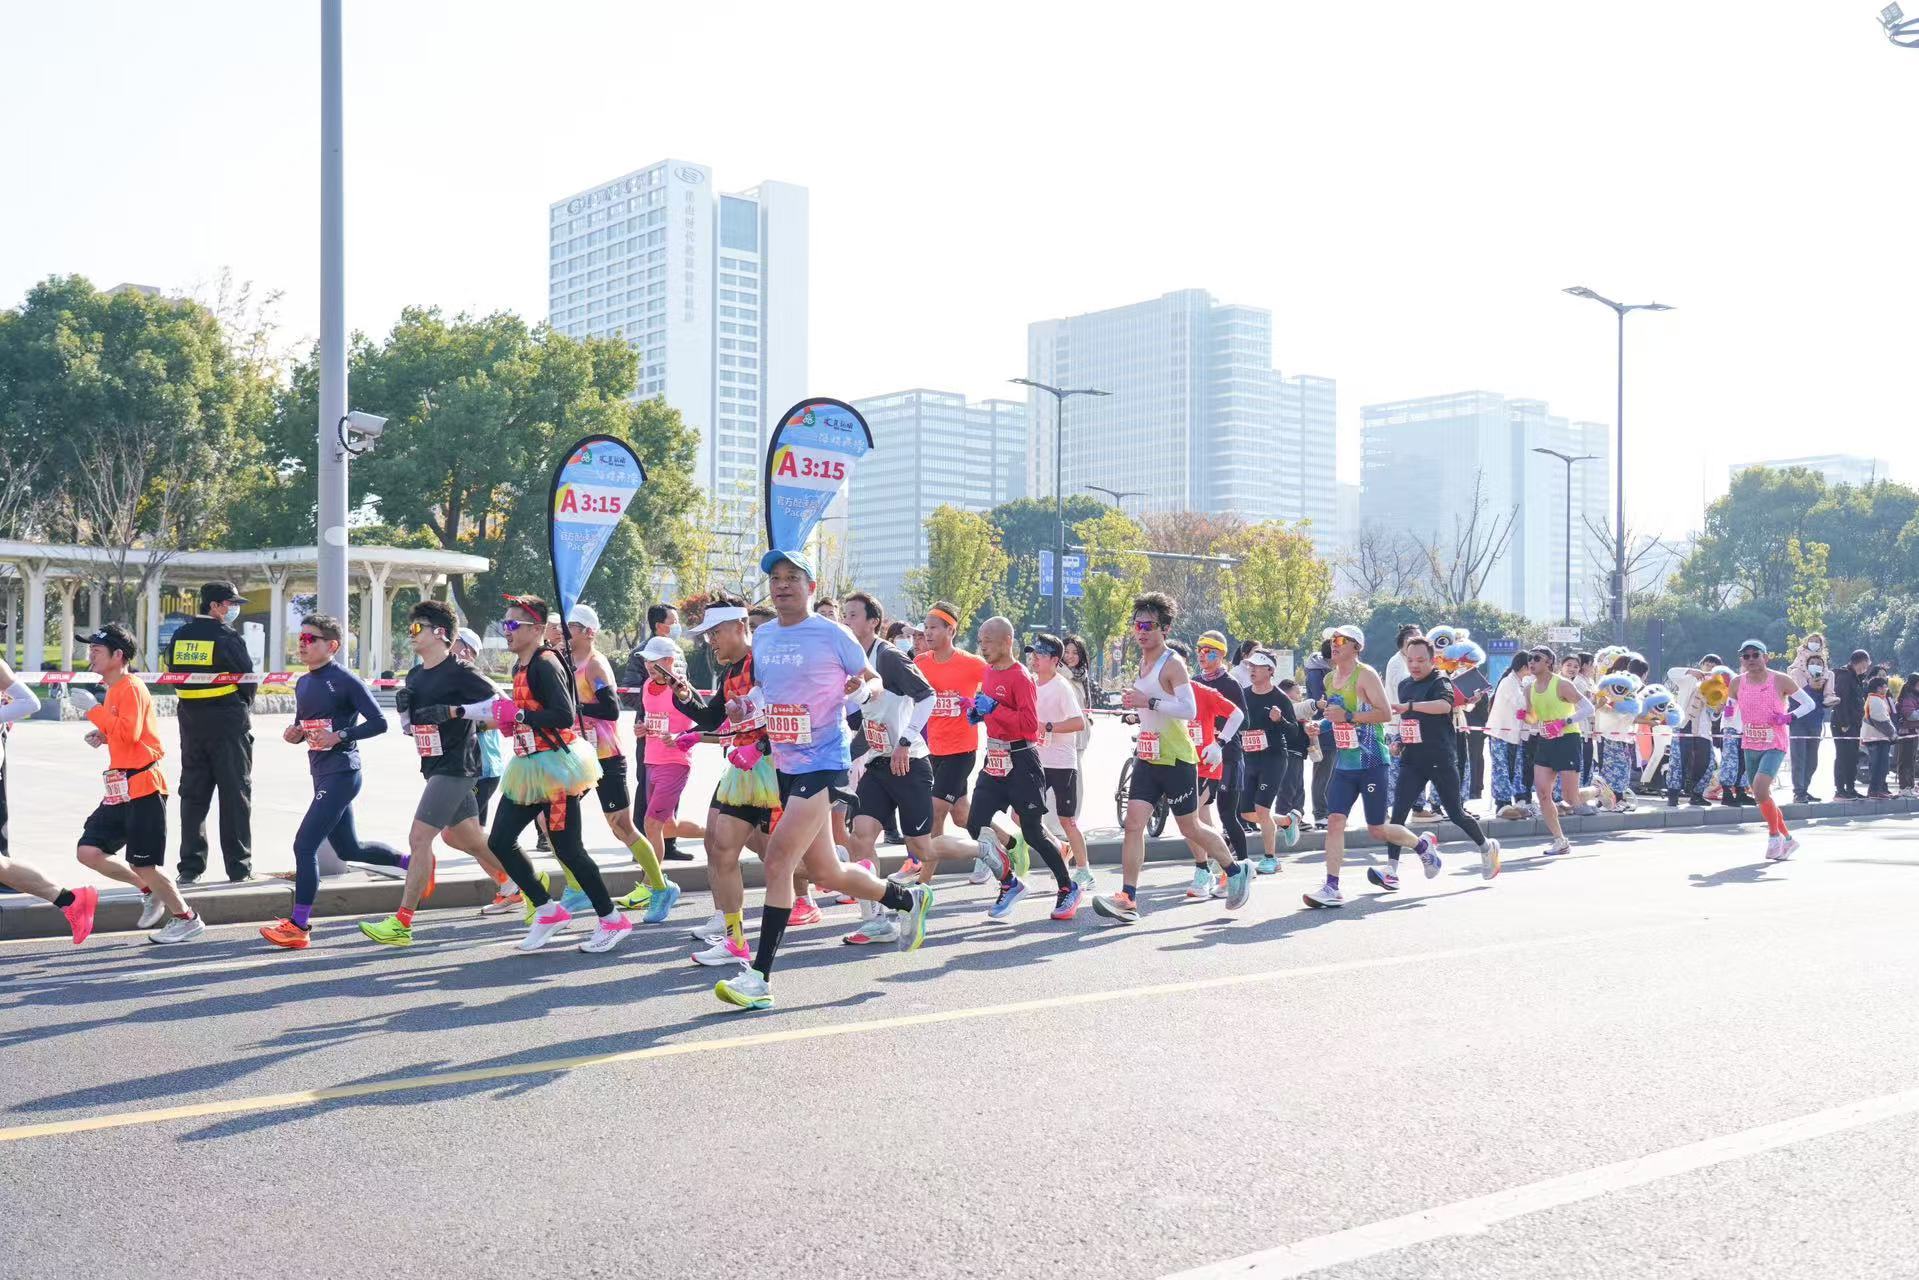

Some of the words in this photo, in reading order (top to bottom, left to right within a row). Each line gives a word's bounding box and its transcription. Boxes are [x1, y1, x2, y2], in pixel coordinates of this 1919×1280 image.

[778, 451, 798, 477] A
[802, 458, 845, 480] 3:15
[561, 489, 578, 513] A
[581, 494, 621, 513] 3:15
[186, 643, 198, 651] TH
[176, 651, 208, 661] 天合保安
